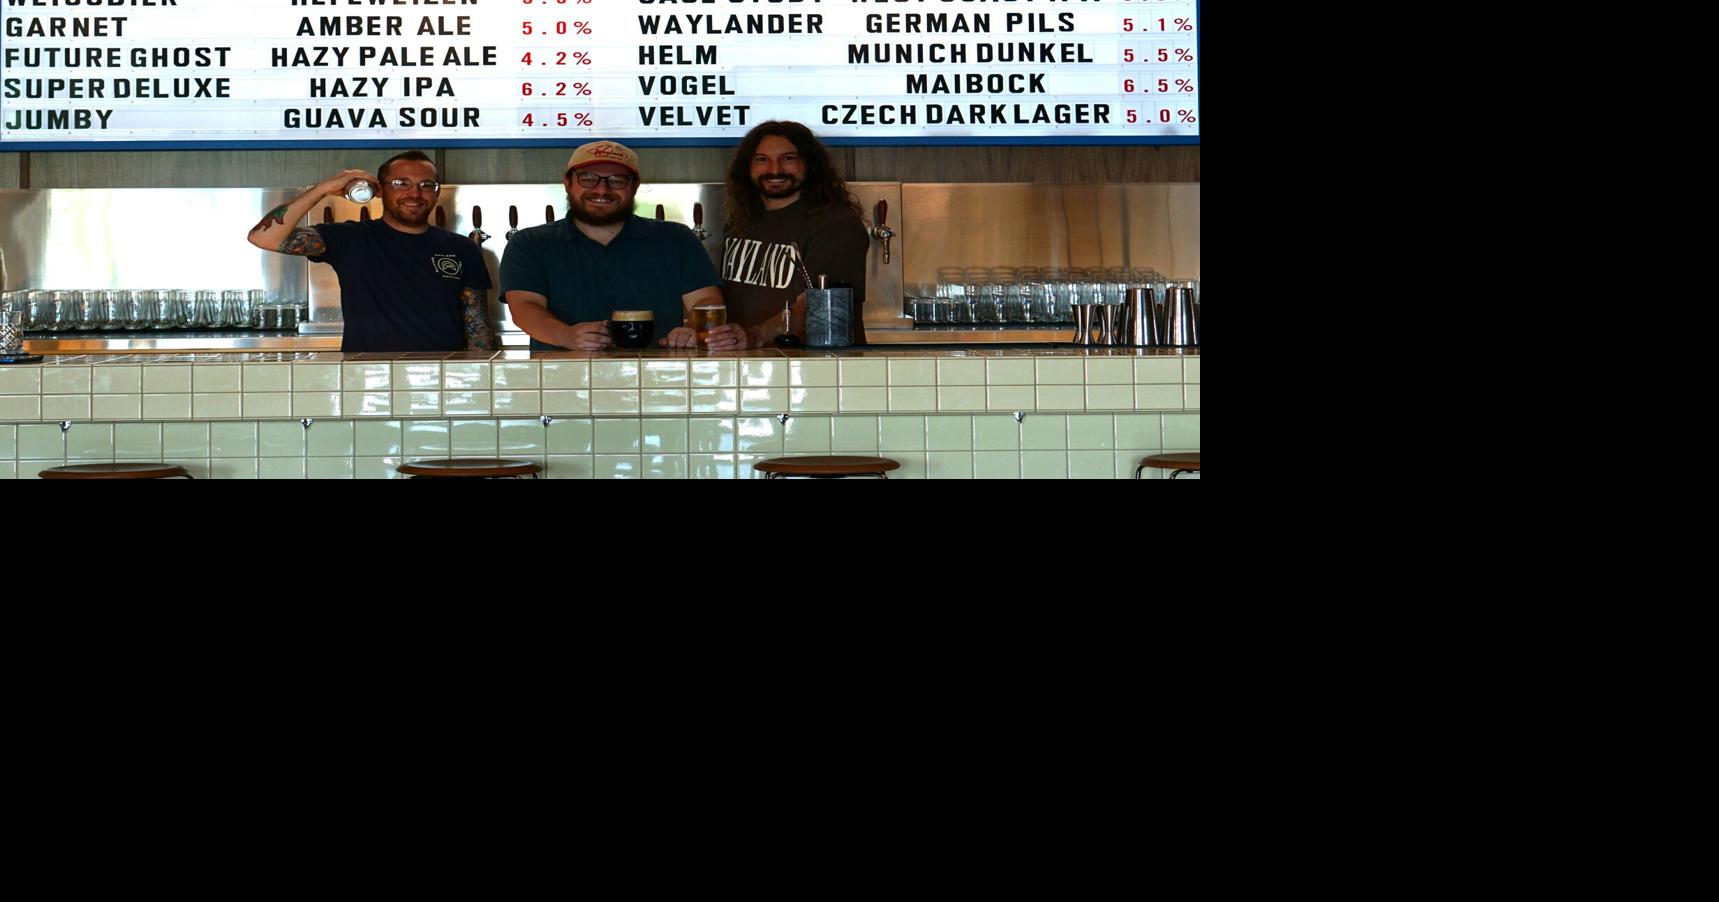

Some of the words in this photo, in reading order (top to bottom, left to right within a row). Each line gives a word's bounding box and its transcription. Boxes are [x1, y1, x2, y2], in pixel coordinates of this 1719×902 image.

[7, 17, 127, 36] GARNET
[297, 16, 402, 35] AMBER
[417, 16, 470, 35] ALE
[638, 14, 822, 34] WAYLANDER
[867, 13, 989, 33] GERMAN
[1007, 13, 1074, 32] PILS
[6, 48, 120, 67] FUTURE
[131, 47, 230, 67] GHOST
[272, 47, 349, 67] HAZY
[360, 47, 433, 66] PALE
[443, 46, 496, 65] ALE
[639, 45, 716, 65] HELM
[849, 43, 966, 63] MUNICH
[977, 43, 1093, 62] DUNKEL
[5, 79, 104, 98] SUPER
[114, 78, 229, 98] DELUXE
[311, 78, 388, 97] HAZY
[404, 77, 454, 96] IPA
[639, 75, 734, 95] VOGEL
[907, 74, 1045, 94] MAIBOCK
[6, 110, 112, 129] JUMBY
[285, 108, 387, 128] GUAVA
[400, 108, 479, 128] SOUR
[639, 106, 750, 126] VELVET
[822, 104, 916, 124] CZECH
[927, 104, 1006, 124] DARK
[1014, 104, 1109, 123] LAGER
